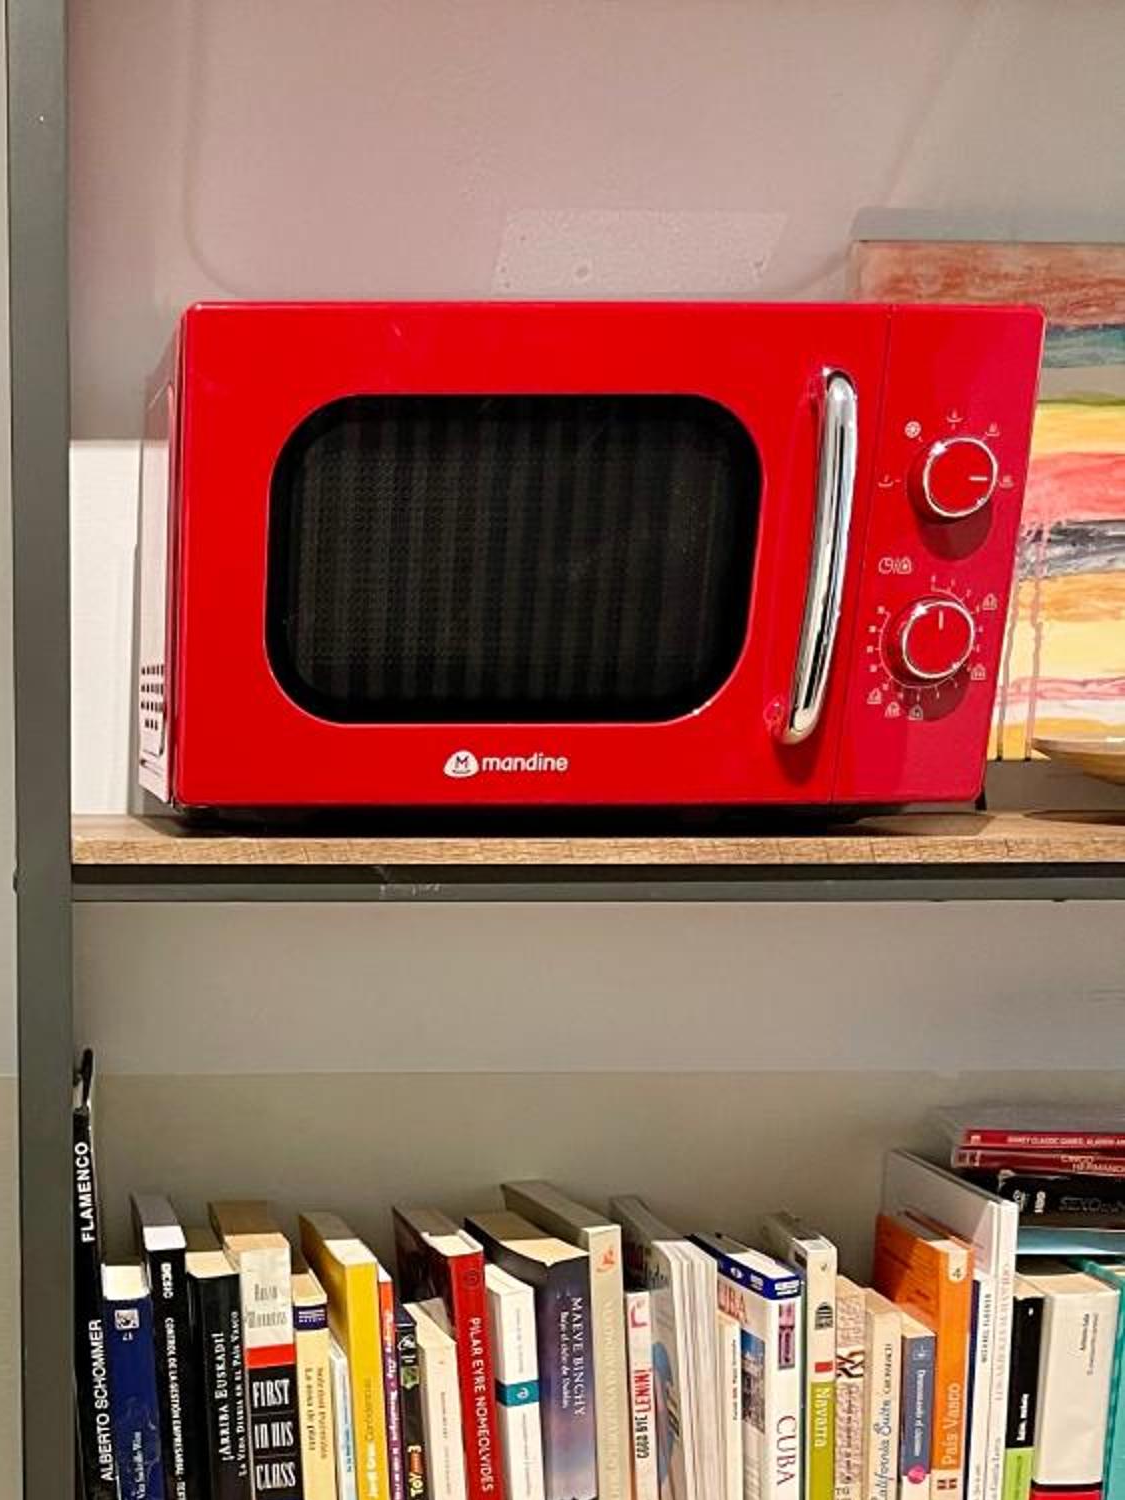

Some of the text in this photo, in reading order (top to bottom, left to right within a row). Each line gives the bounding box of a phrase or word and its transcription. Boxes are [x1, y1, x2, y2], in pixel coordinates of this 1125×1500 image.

[482, 752, 568, 772] mandine
[74, 1142, 96, 1242] FLAMENCO
[165, 1318, 175, 1356] CONTROL
[571, 1297, 586, 1416] MAEVE BINCHY
[168, 1358, 177, 1368] DE
[168, 1370, 178, 1380] LA
[88, 1319, 115, 1481] ALBERTO SCHOMMER
[252, 1379, 290, 1409] FIRST
[469, 1317, 494, 1491] PILAR EYRE NOMEOLVIDES
[634, 1368, 653, 1413] LENIN!
[254, 1421, 294, 1449] IN HIS
[815, 1387, 830, 1447] Navarra
[873, 1400, 891, 1437] Suite
[941, 1383, 960, 1465] País Vasco
[172, 1420, 184, 1477] EMPRESARIAL
[776, 1415, 797, 1486] CUBA
[255, 1461, 296, 1490] CLASS
[409, 1472, 424, 1497] TOY
